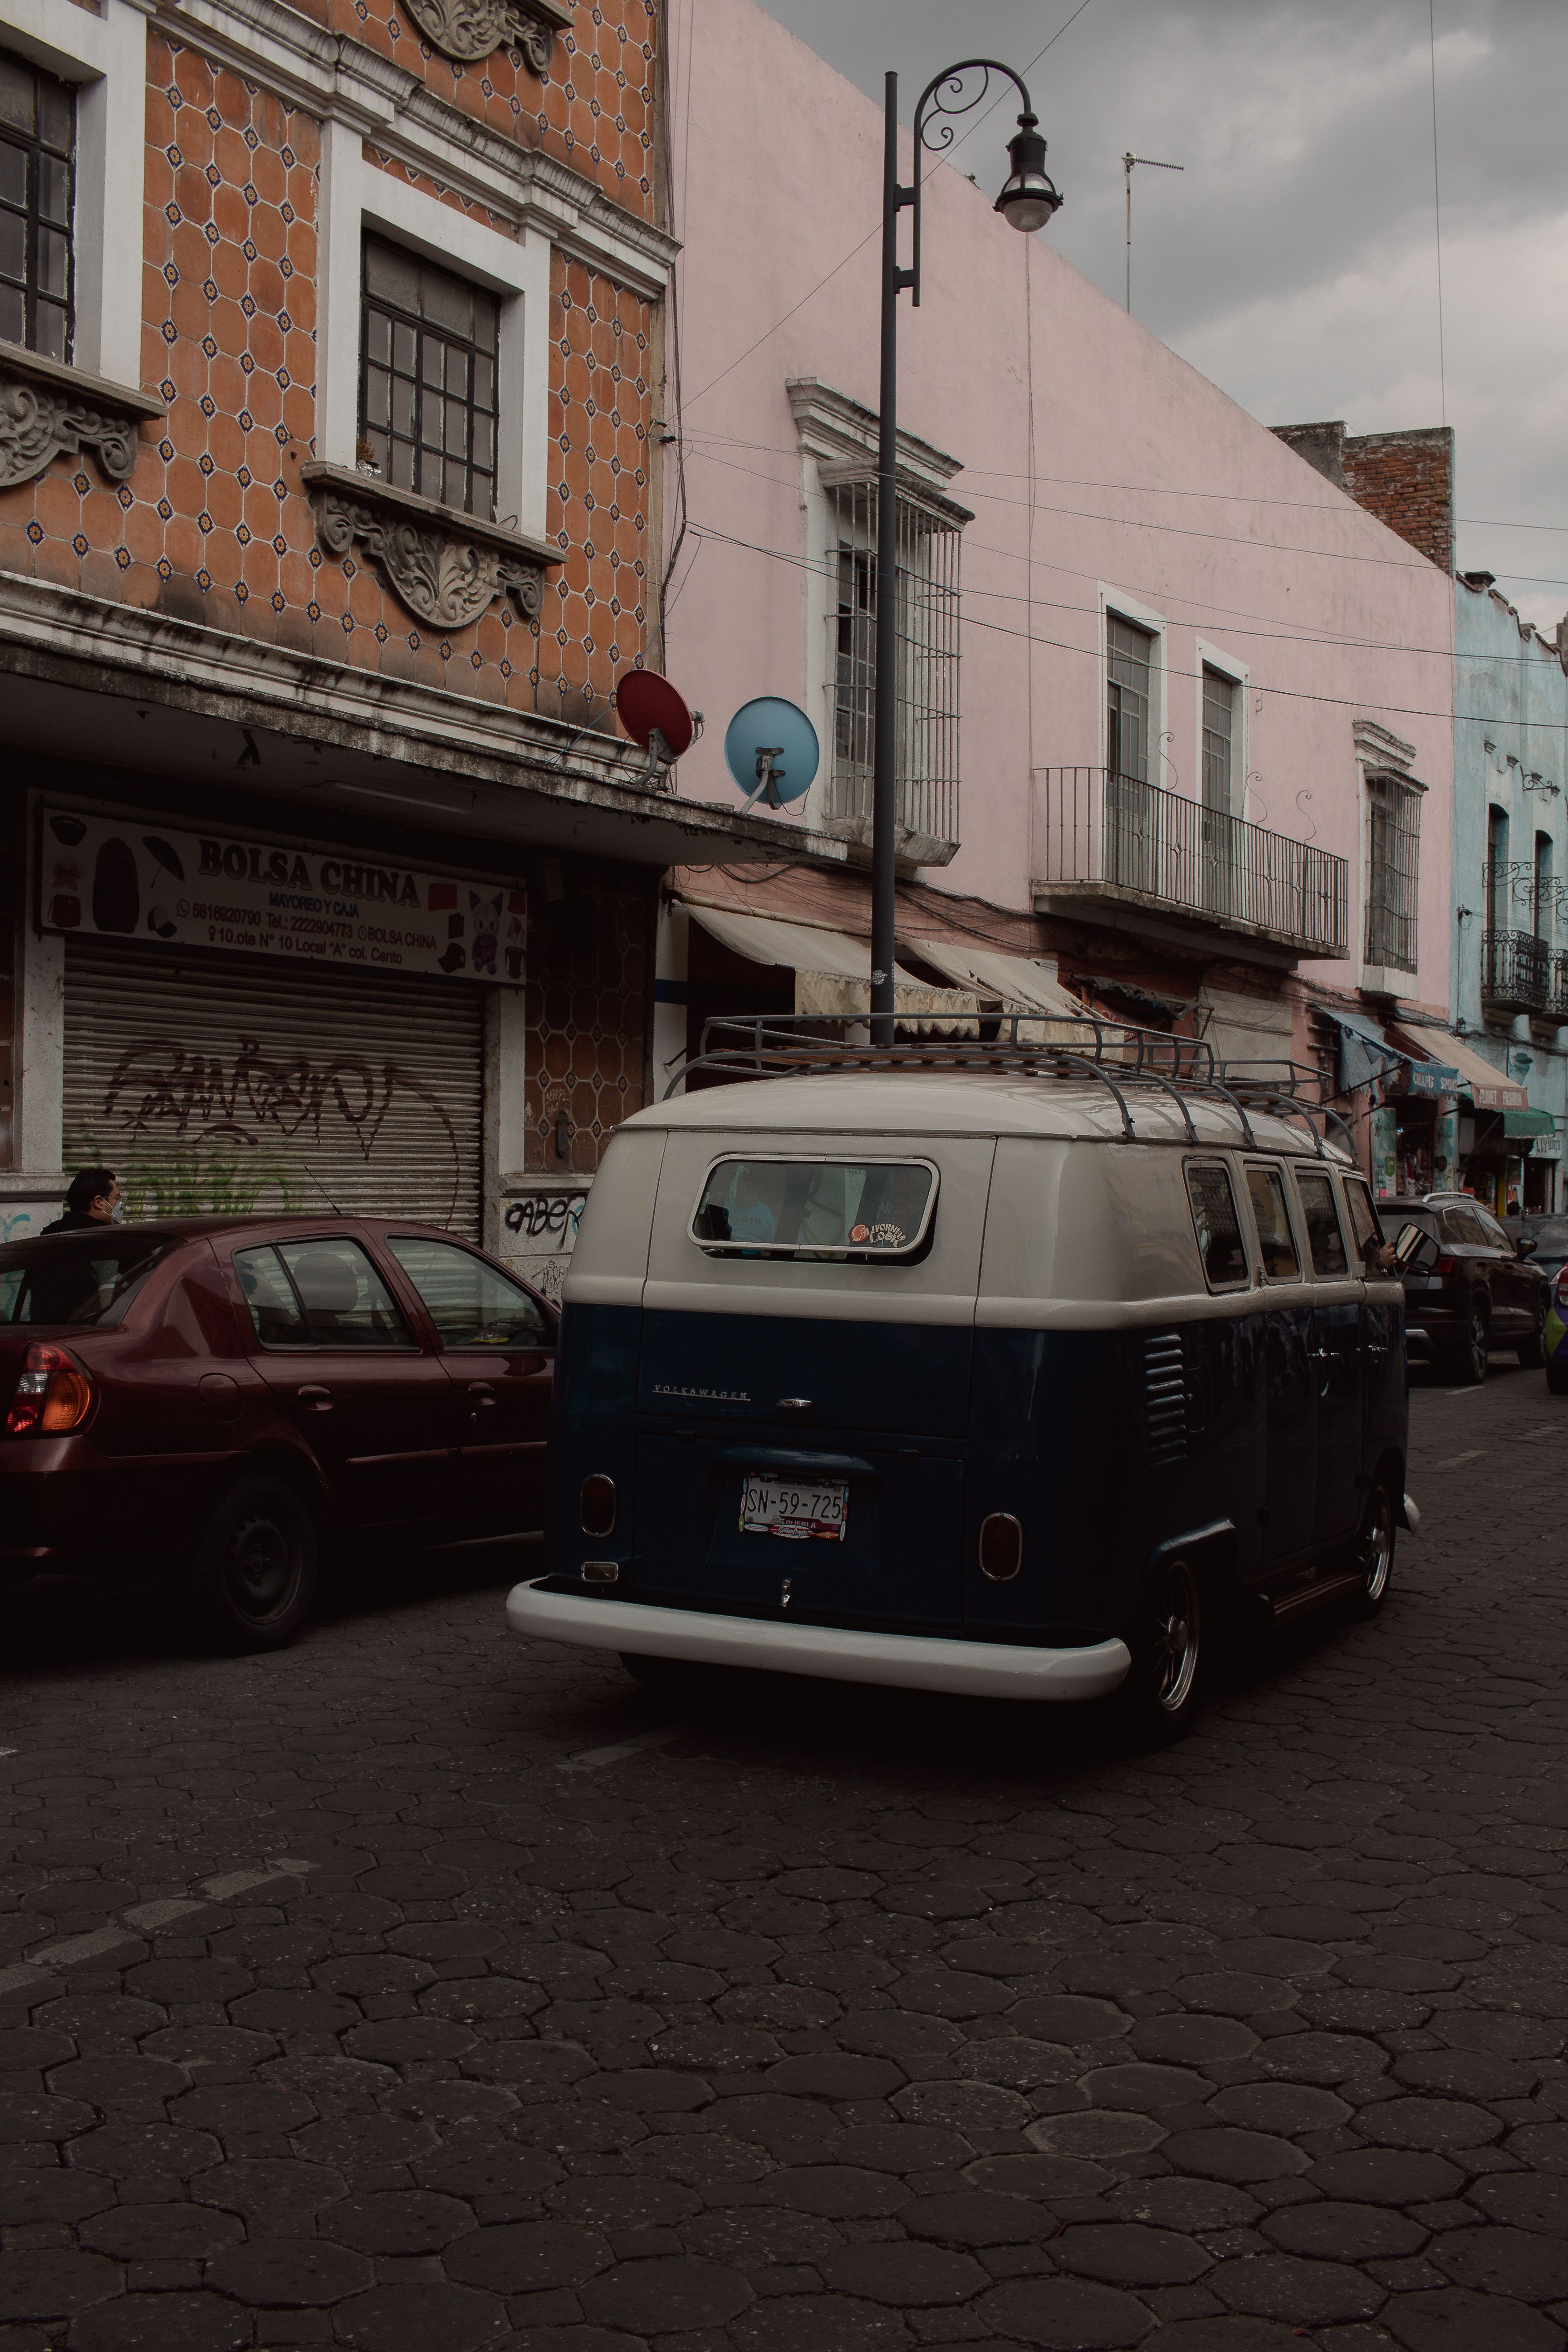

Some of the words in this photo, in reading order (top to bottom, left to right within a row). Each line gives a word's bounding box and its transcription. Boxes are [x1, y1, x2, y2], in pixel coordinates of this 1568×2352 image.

[198, 839, 313, 890] BOLSA
[320, 861, 421, 908] CHINA
[269, 892, 322, 912] MAYOREO
[323, 900, 332, 914] Y
[333, 902, 360, 919] CAJA
[192, 902, 261, 926] 5616920790
[266, 912, 288, 930] Tel.:
[291, 916, 353, 939] 2222904773
[368, 926, 403, 945] BOLSA
[405, 932, 437, 951] CHINA
[218, 927, 256, 946] 10.ote
[279, 935, 293, 951] 10
[296, 937, 326, 955] Local
[349, 946, 368, 960] col.
[371, 947, 402, 964] Cento
[852, 1223, 906, 1242] CALIFORNIA
[869, 1231, 899, 1248] LOOK
[654, 1385, 747, 1400] VOLKSWAGEN
[747, 1488, 842, 1519] SN-59-725
